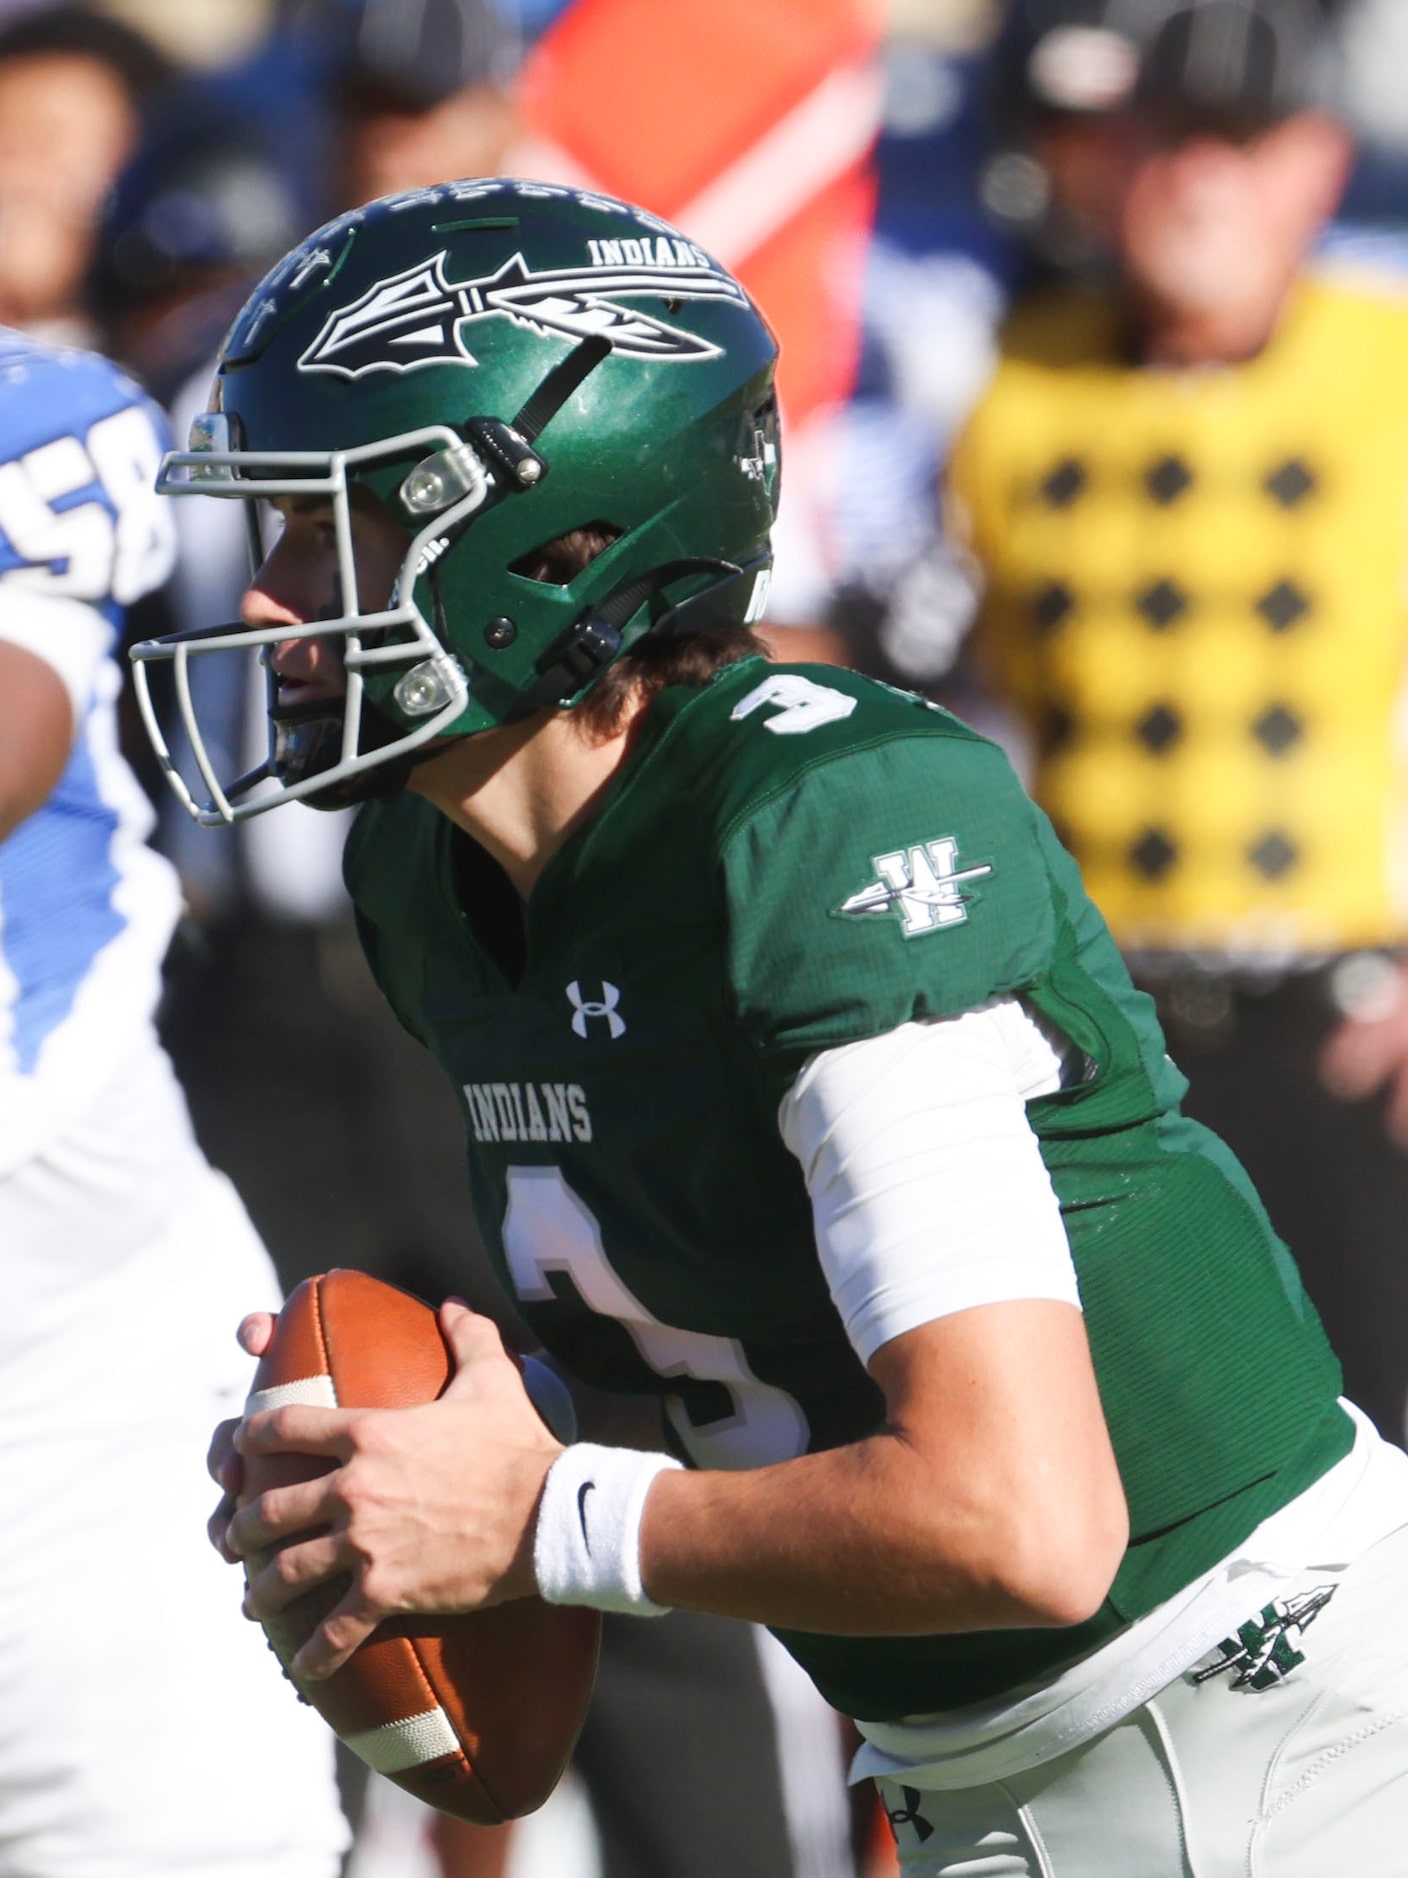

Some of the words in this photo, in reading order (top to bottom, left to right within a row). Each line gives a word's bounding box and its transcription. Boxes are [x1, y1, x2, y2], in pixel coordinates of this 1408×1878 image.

[587, 236, 711, 268] INDIANS
[729, 674, 858, 735] 3
[871, 836, 967, 938] W
[463, 1082, 593, 1143] INDIANS
[501, 1165, 811, 1472] 3
